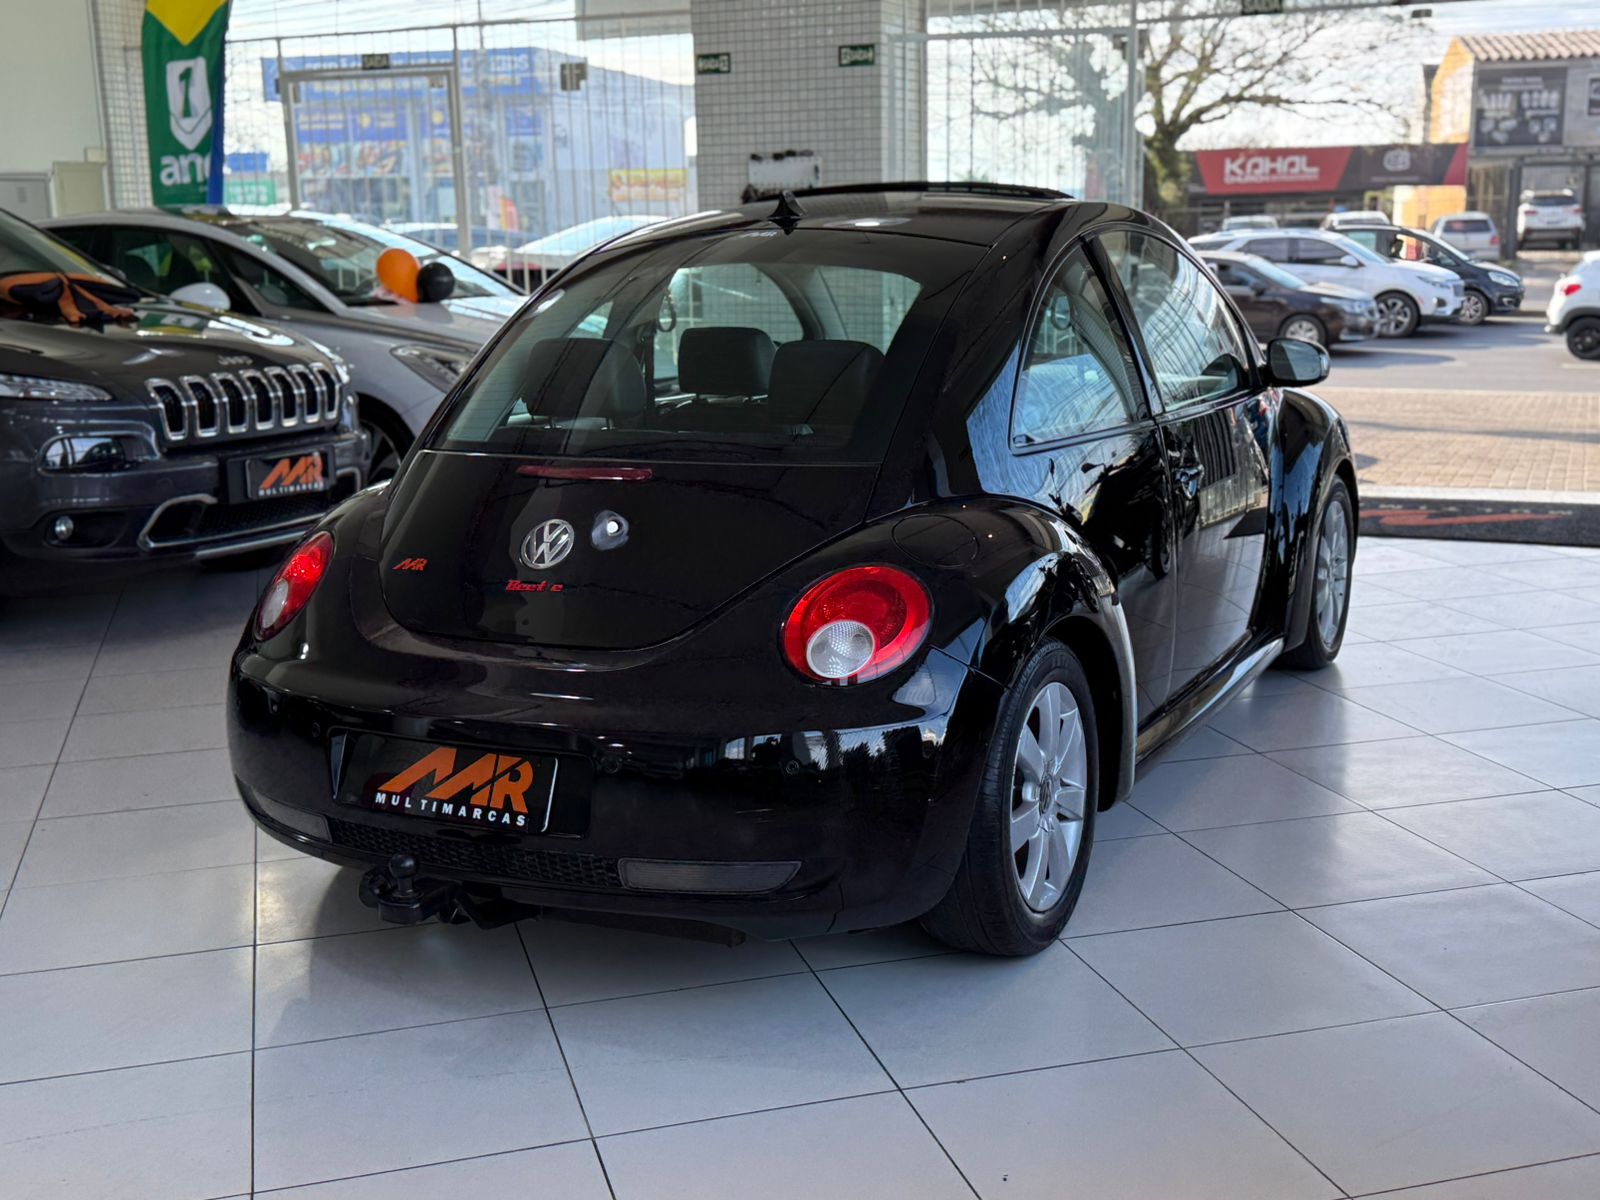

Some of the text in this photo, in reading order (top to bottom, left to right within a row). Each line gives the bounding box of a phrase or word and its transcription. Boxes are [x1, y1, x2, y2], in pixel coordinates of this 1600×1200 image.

[217, 355, 253, 366] Jeep
[506, 579, 564, 592] Beete
[375, 792, 526, 827] MULTIMARCAS
